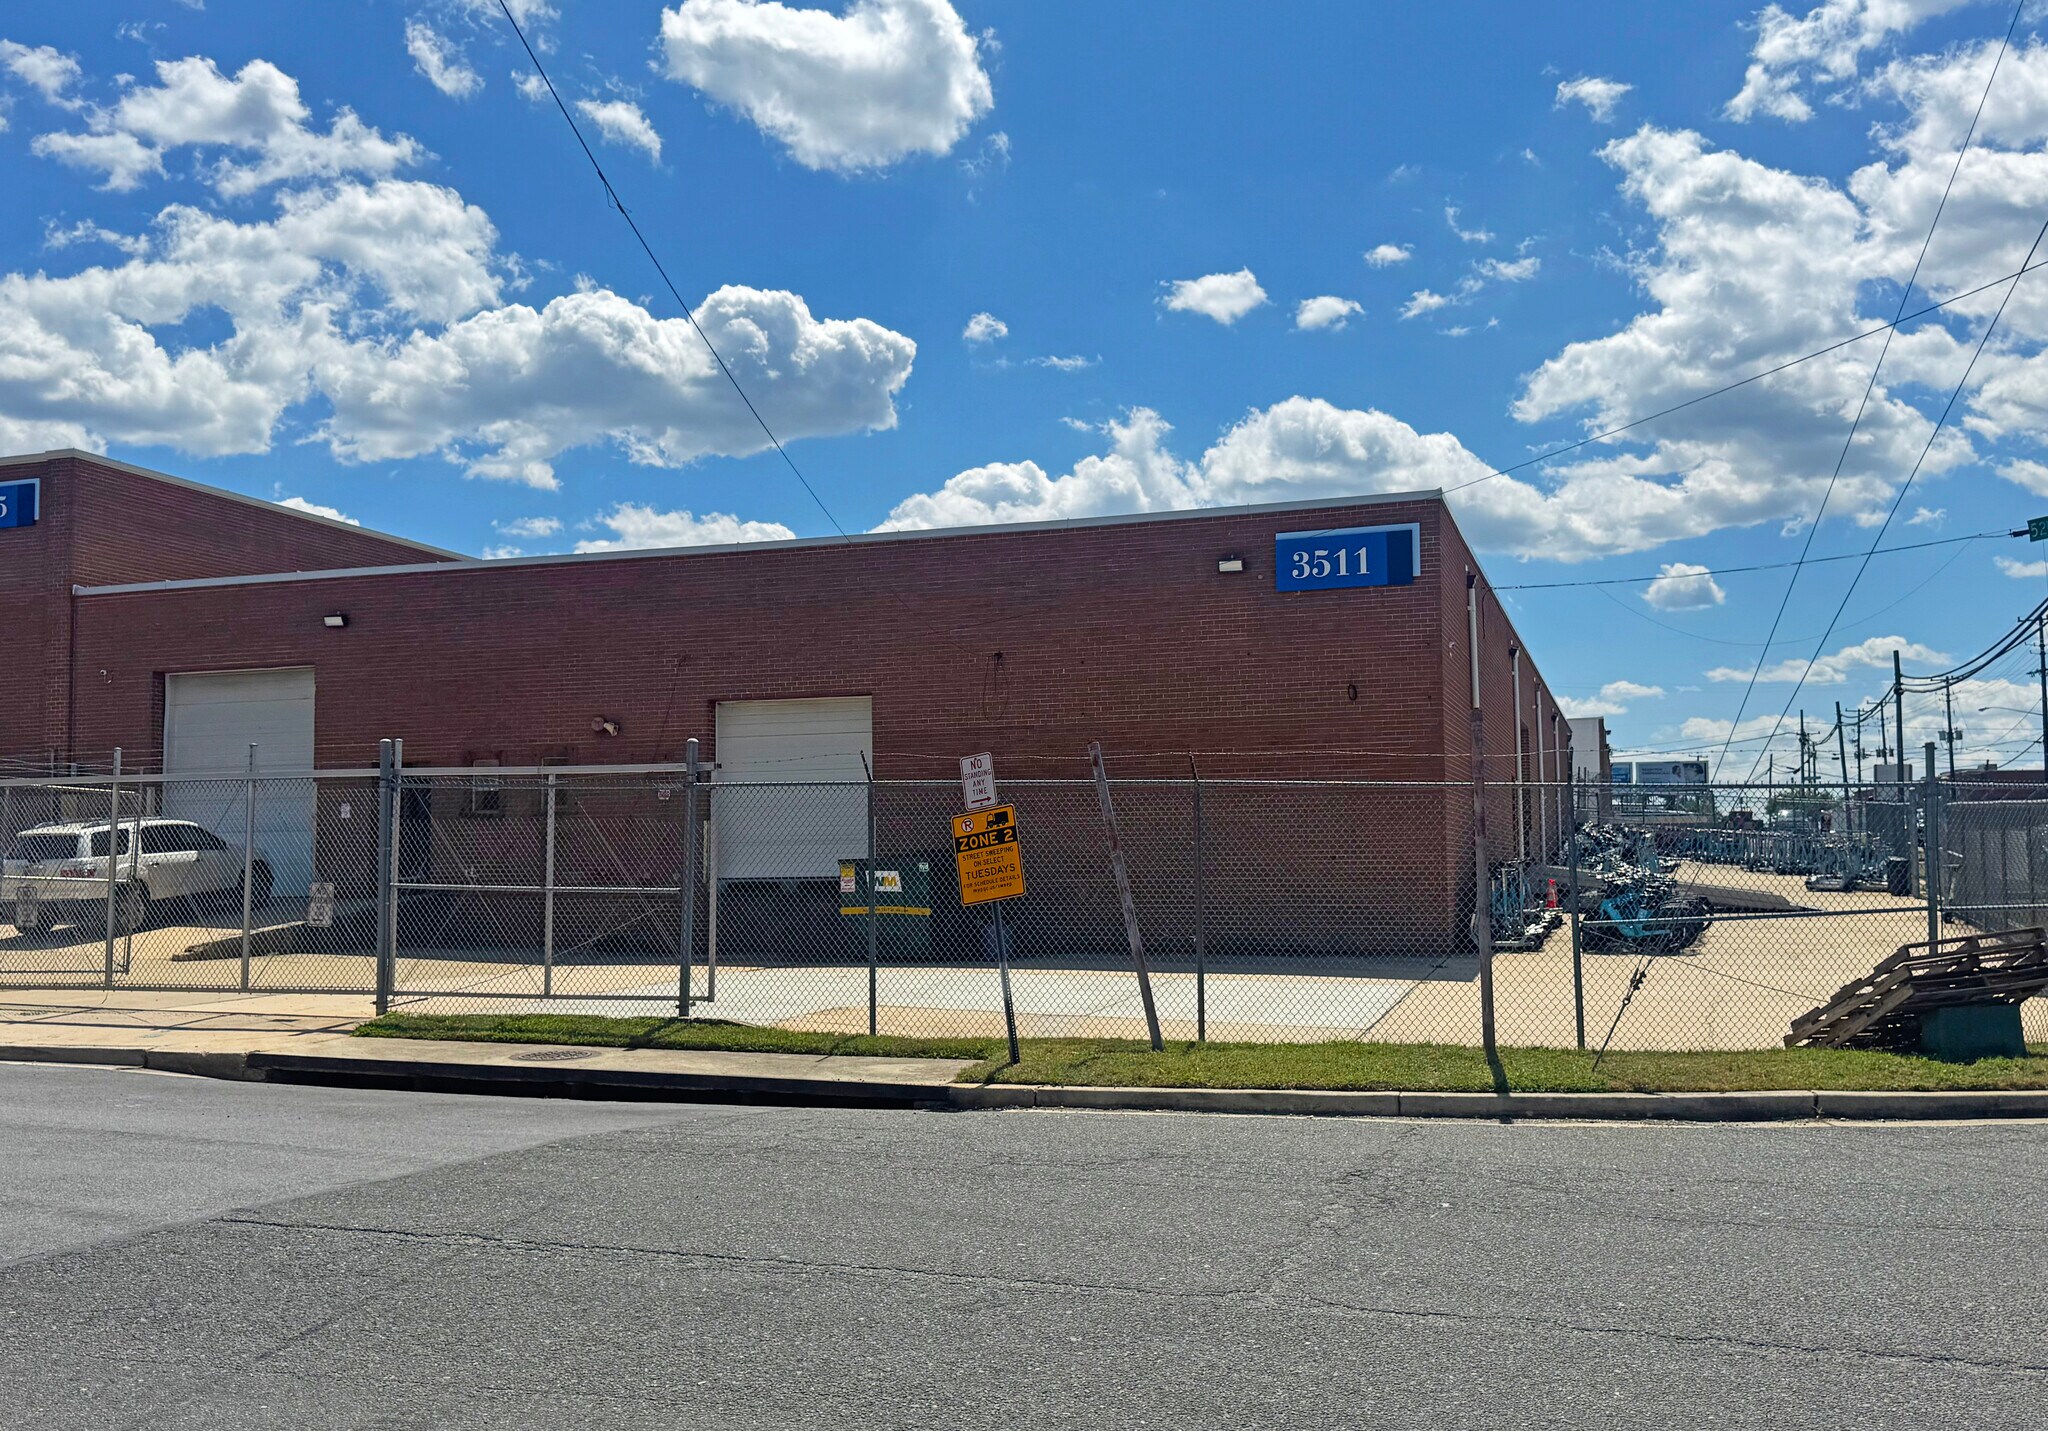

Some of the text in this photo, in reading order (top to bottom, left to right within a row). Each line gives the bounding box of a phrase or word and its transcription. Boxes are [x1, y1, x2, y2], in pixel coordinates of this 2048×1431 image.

[2030, 521, 2048, 538] 52
[1292, 546, 1370, 579] 3511
[970, 759, 982, 770] NO
[965, 769, 991, 780] STANDING
[973, 779, 985, 787] ANY
[972, 786, 988, 796] TIME
[959, 828, 1014, 851] ZONE 2
[962, 845, 1014, 862] STREET SWEEPING
[983, 855, 1004, 866] SELECT
[965, 863, 1015, 880] TUESDAYS
